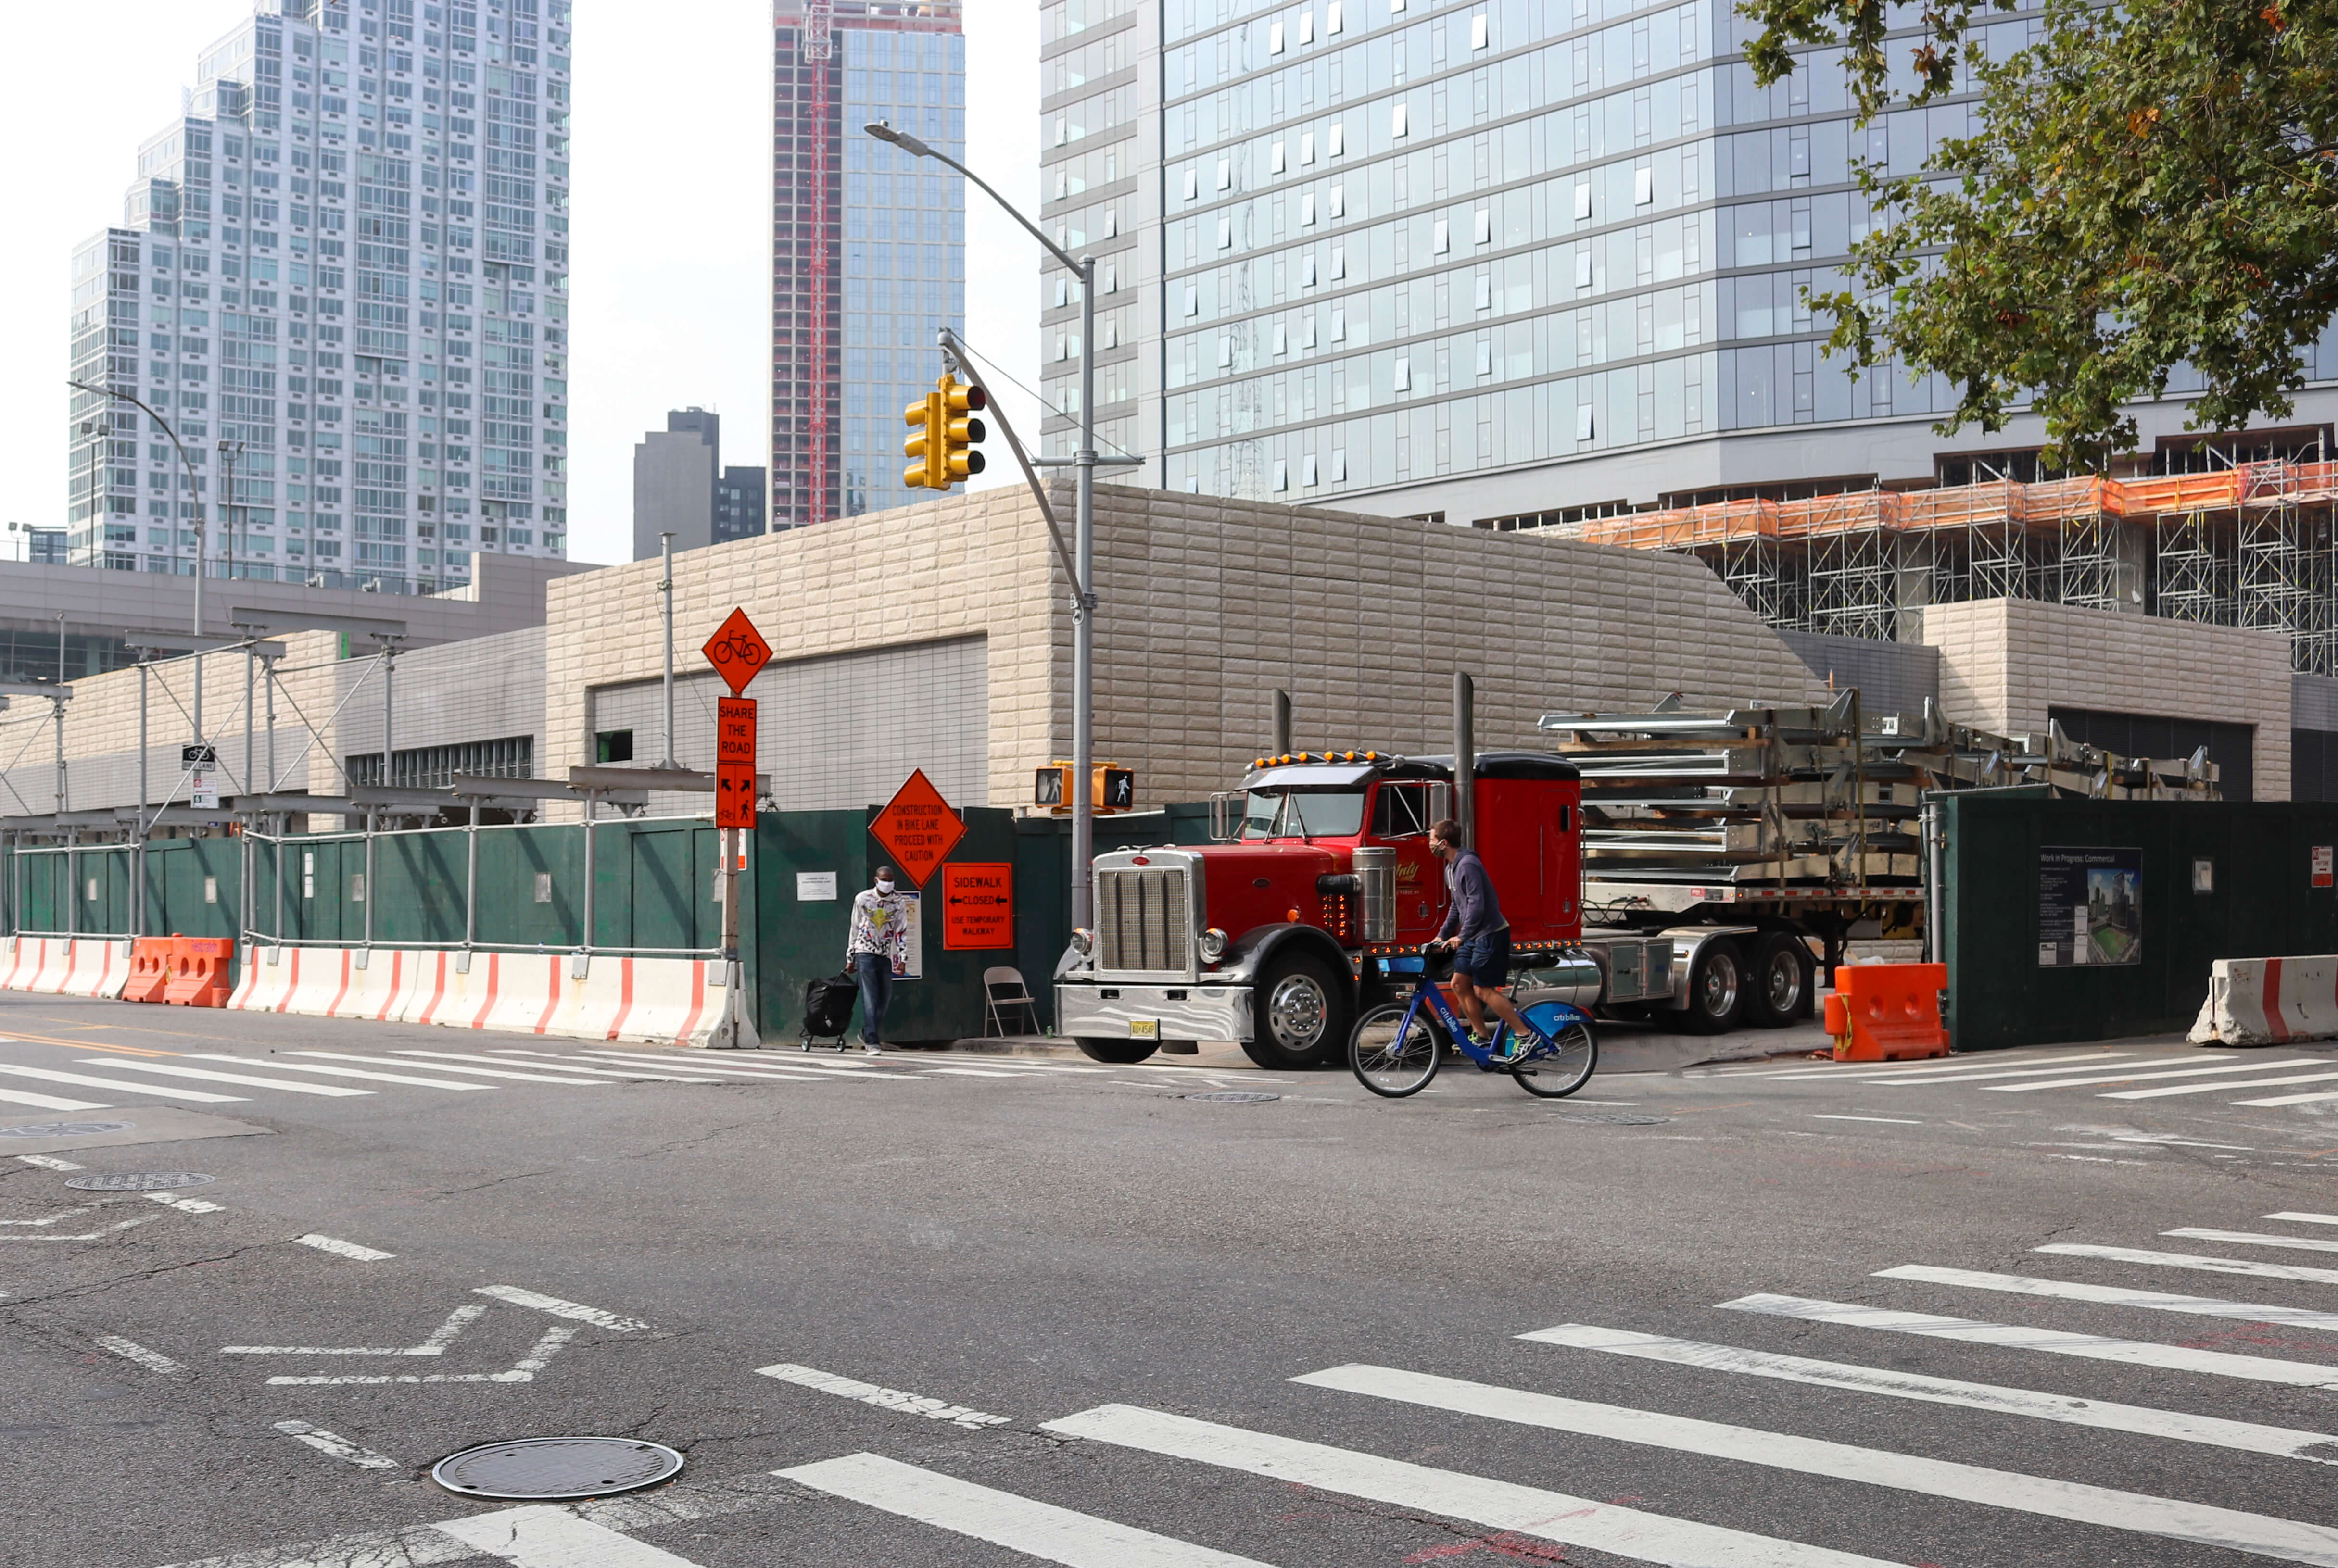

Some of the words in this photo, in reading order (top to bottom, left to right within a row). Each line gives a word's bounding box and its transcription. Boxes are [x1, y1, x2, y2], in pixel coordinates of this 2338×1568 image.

[720, 706, 755, 719] SHARE
[727, 724, 746, 736] THE
[722, 741, 751, 754] ROAD
[893, 804, 942, 816] CONSTRUCTION
[896, 819, 903, 830] IN
[905, 819, 920, 830] BIKE
[922, 819, 939, 830] LANE
[895, 834, 924, 846] PROCEED
[927, 834, 943, 845] WITH
[904, 850, 933, 862] CAUTION
[2040, 854, 2055, 862] Work
[2055, 853, 2060, 862] in
[2061, 854, 2084, 864] Progress:
[2085, 854, 2115, 863] Commercial
[954, 877, 1002, 888] SIDEWALK
[962, 896, 994, 905] CLOSED
[966, 916, 1005, 924] TEMPORARY
